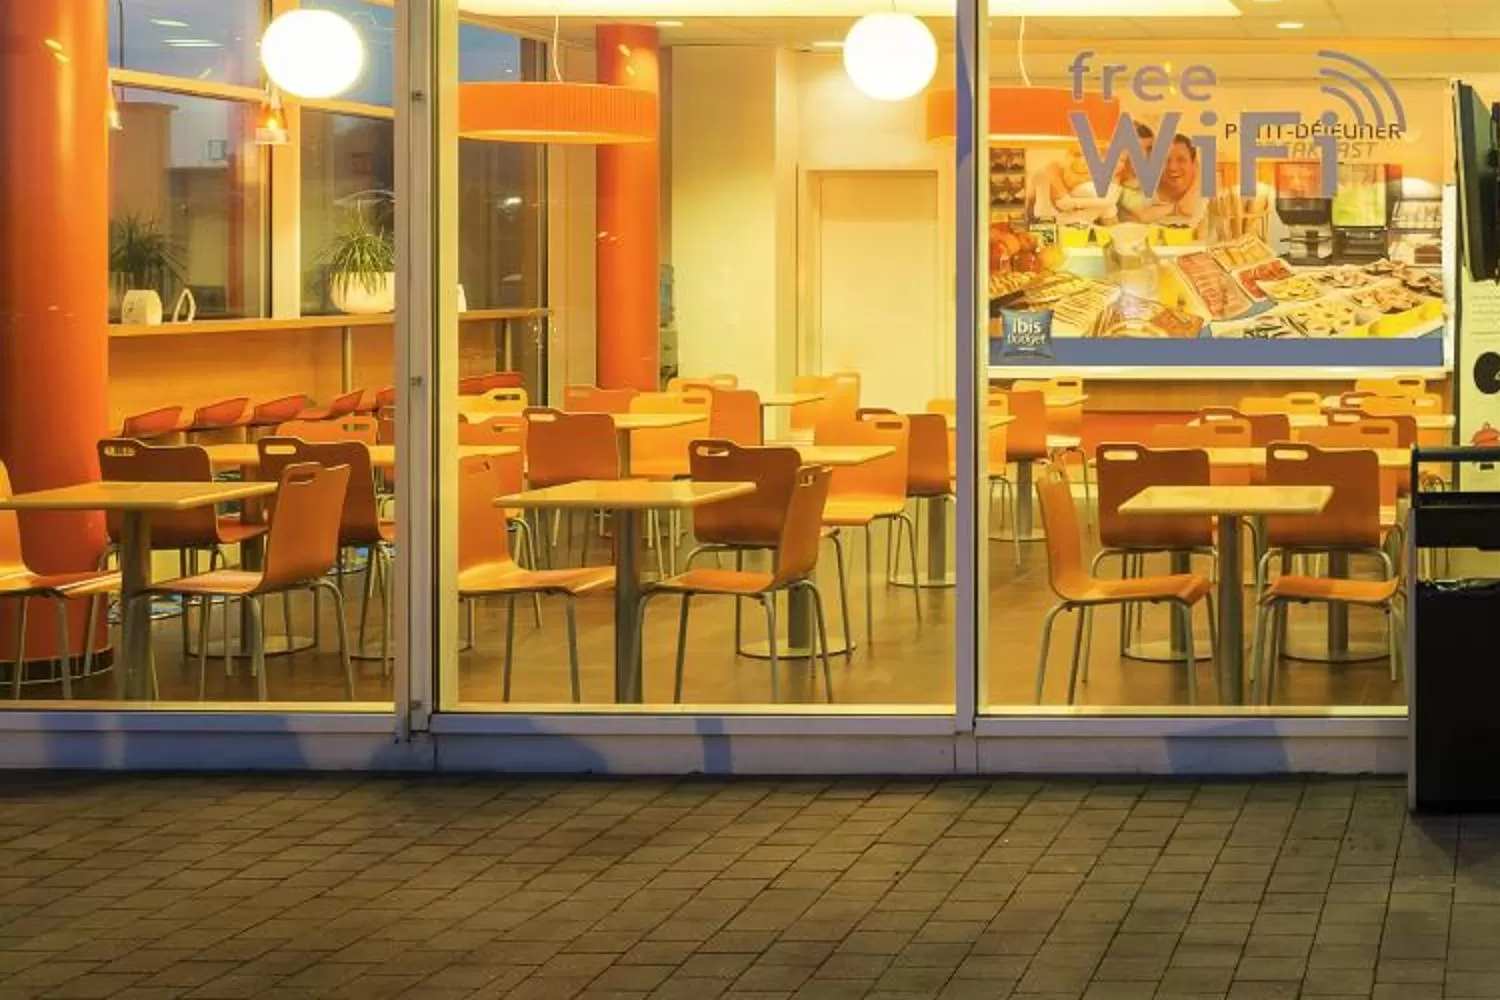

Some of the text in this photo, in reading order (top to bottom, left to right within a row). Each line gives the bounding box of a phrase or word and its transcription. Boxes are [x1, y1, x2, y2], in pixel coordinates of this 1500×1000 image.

[1068, 50, 1218, 101] free
[1069, 110, 1340, 200] WiFi
[1224, 119, 1401, 140] PTIT-DÉEUNER
